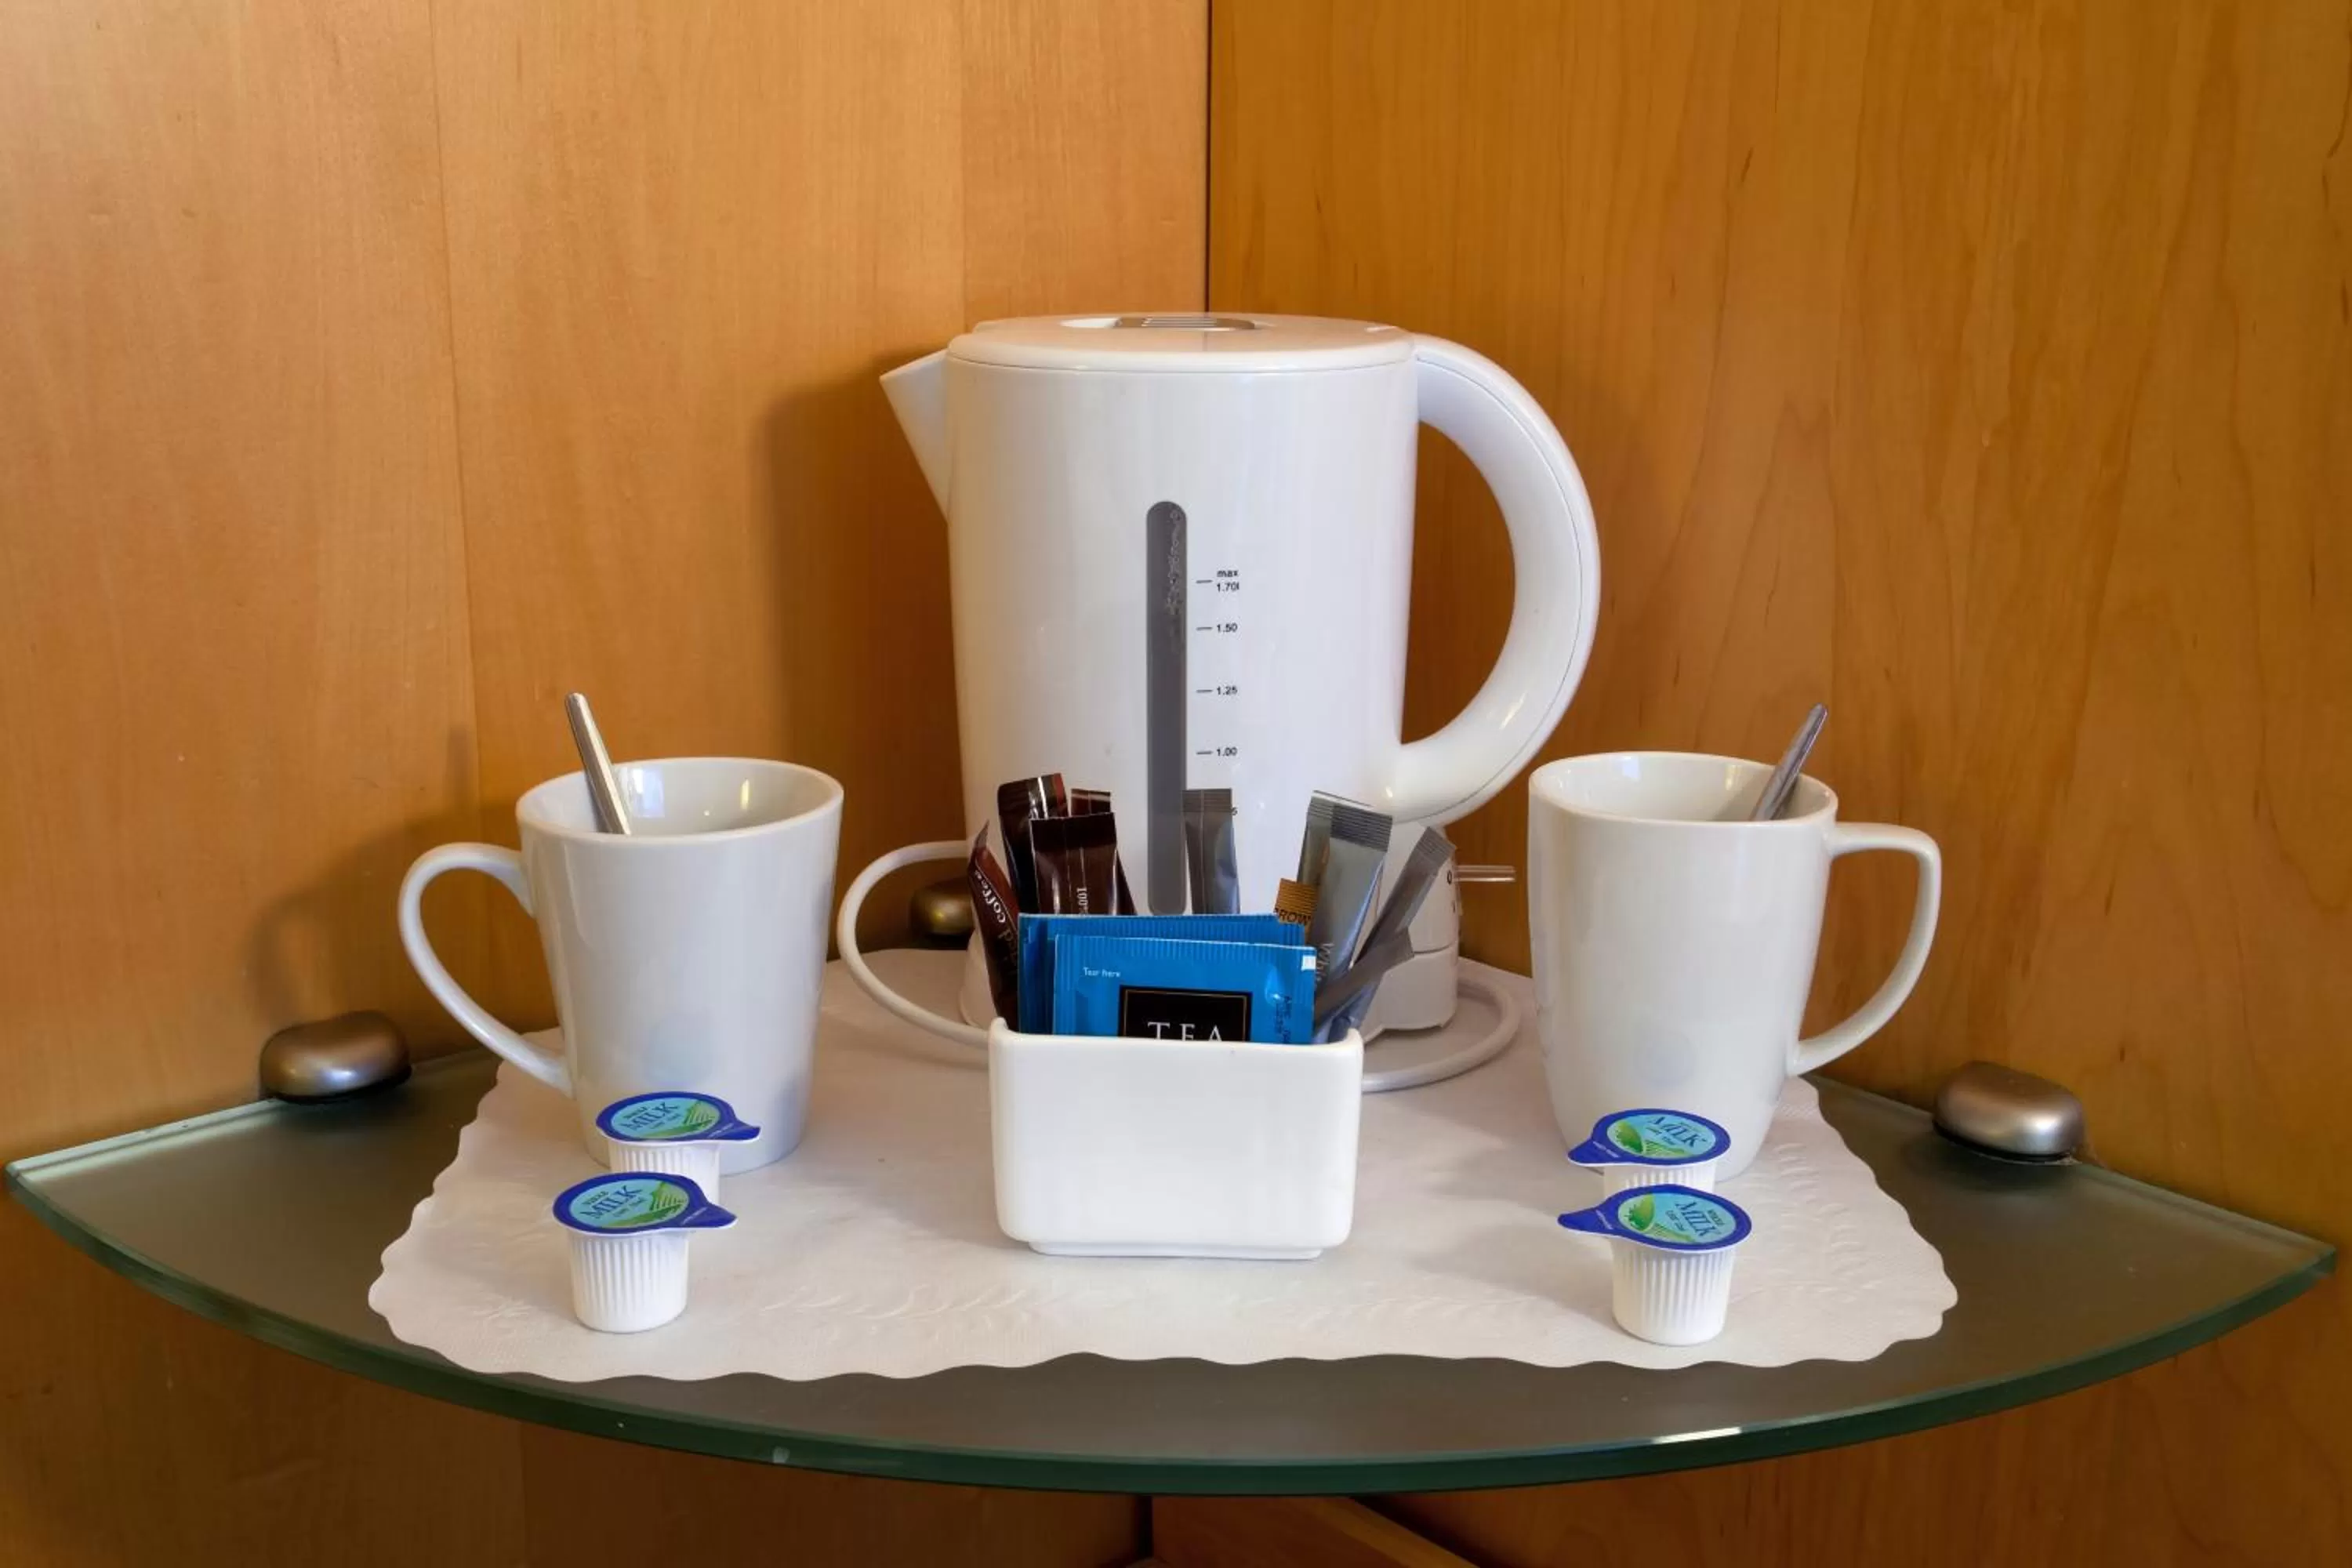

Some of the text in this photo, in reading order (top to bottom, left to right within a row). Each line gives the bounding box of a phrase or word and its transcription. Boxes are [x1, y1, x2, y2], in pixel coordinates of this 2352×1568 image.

[1217, 622, 1238, 633] 1.50
[1217, 686, 1238, 695] 1.25
[1216, 746, 1238, 757] 1.00
[1083, 967, 1121, 978] Tear here
[1147, 1021, 1222, 1041] TEA
[620, 1102, 679, 1131] MILK
[1647, 1116, 1707, 1148] MILK
[580, 1185, 642, 1220] MILK
[1675, 1201, 1722, 1237] MILK
